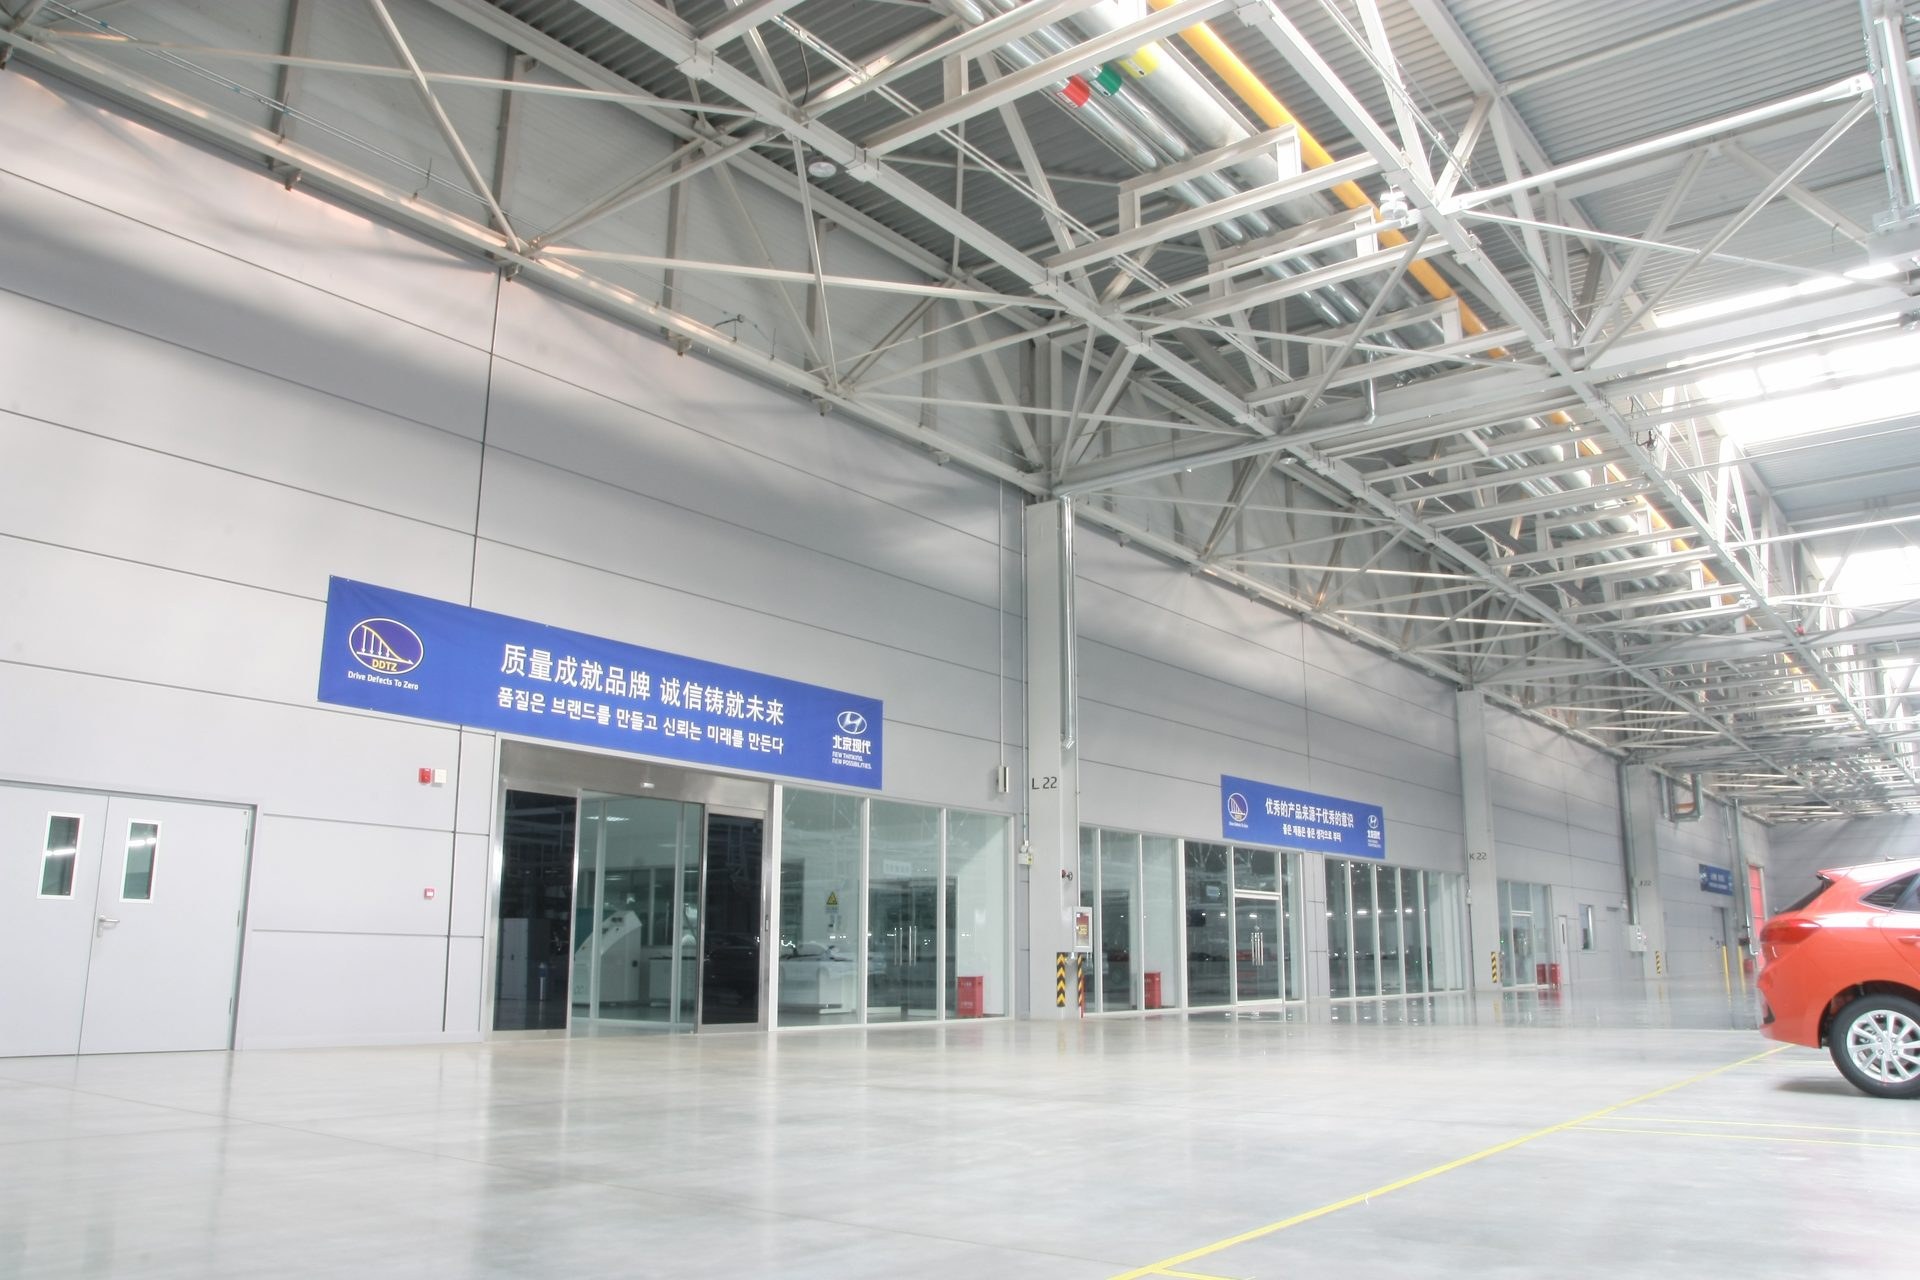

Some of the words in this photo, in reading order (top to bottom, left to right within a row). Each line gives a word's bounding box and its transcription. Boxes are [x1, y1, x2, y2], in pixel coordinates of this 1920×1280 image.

[372, 659, 398, 672] DDTZ
[347, 670, 366, 681] Drive
[367, 674, 393, 686] Defects
[394, 679, 403, 688] To
[403, 681, 419, 690] Zero
[500, 643, 651, 701] 质量成就品牌
[660, 677, 784, 726] 诚信铸就未来
[497, 686, 546, 714] 품질은
[551, 697, 612, 726] 브랜드를
[616, 708, 658, 732] 만들고
[663, 717, 703, 741] 신뢰는
[707, 725, 744, 749] 미래를
[748, 732, 784, 755] 만든다
[832, 734, 871, 755] 北京现代
